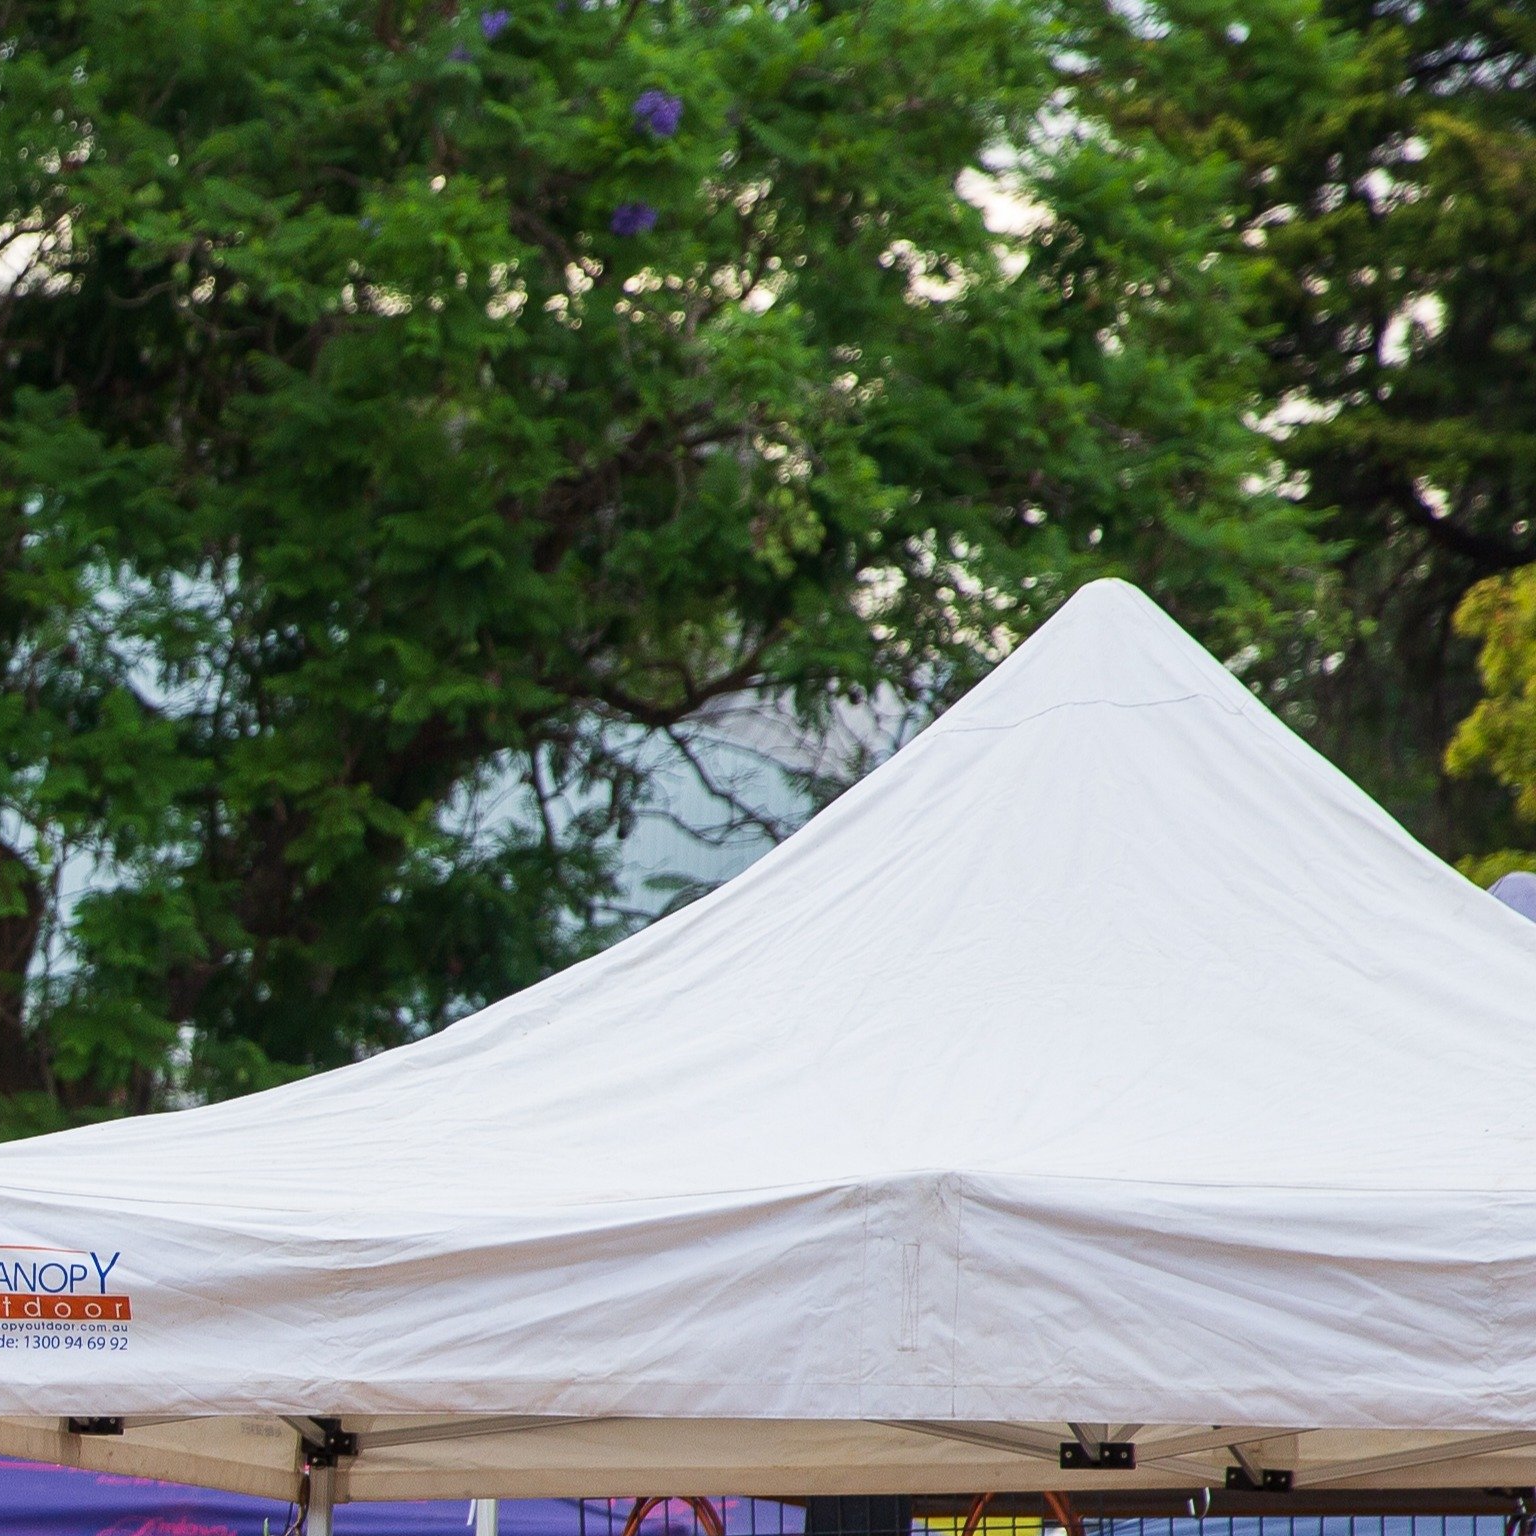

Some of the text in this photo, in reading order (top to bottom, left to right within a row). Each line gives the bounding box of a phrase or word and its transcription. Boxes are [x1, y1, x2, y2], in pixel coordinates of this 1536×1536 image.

[25, 1335, 60, 1349] 1300
[64, 1335, 82, 1350] 94
[87, 1336, 106, 1350] 69
[110, 1337, 128, 1350] 92
